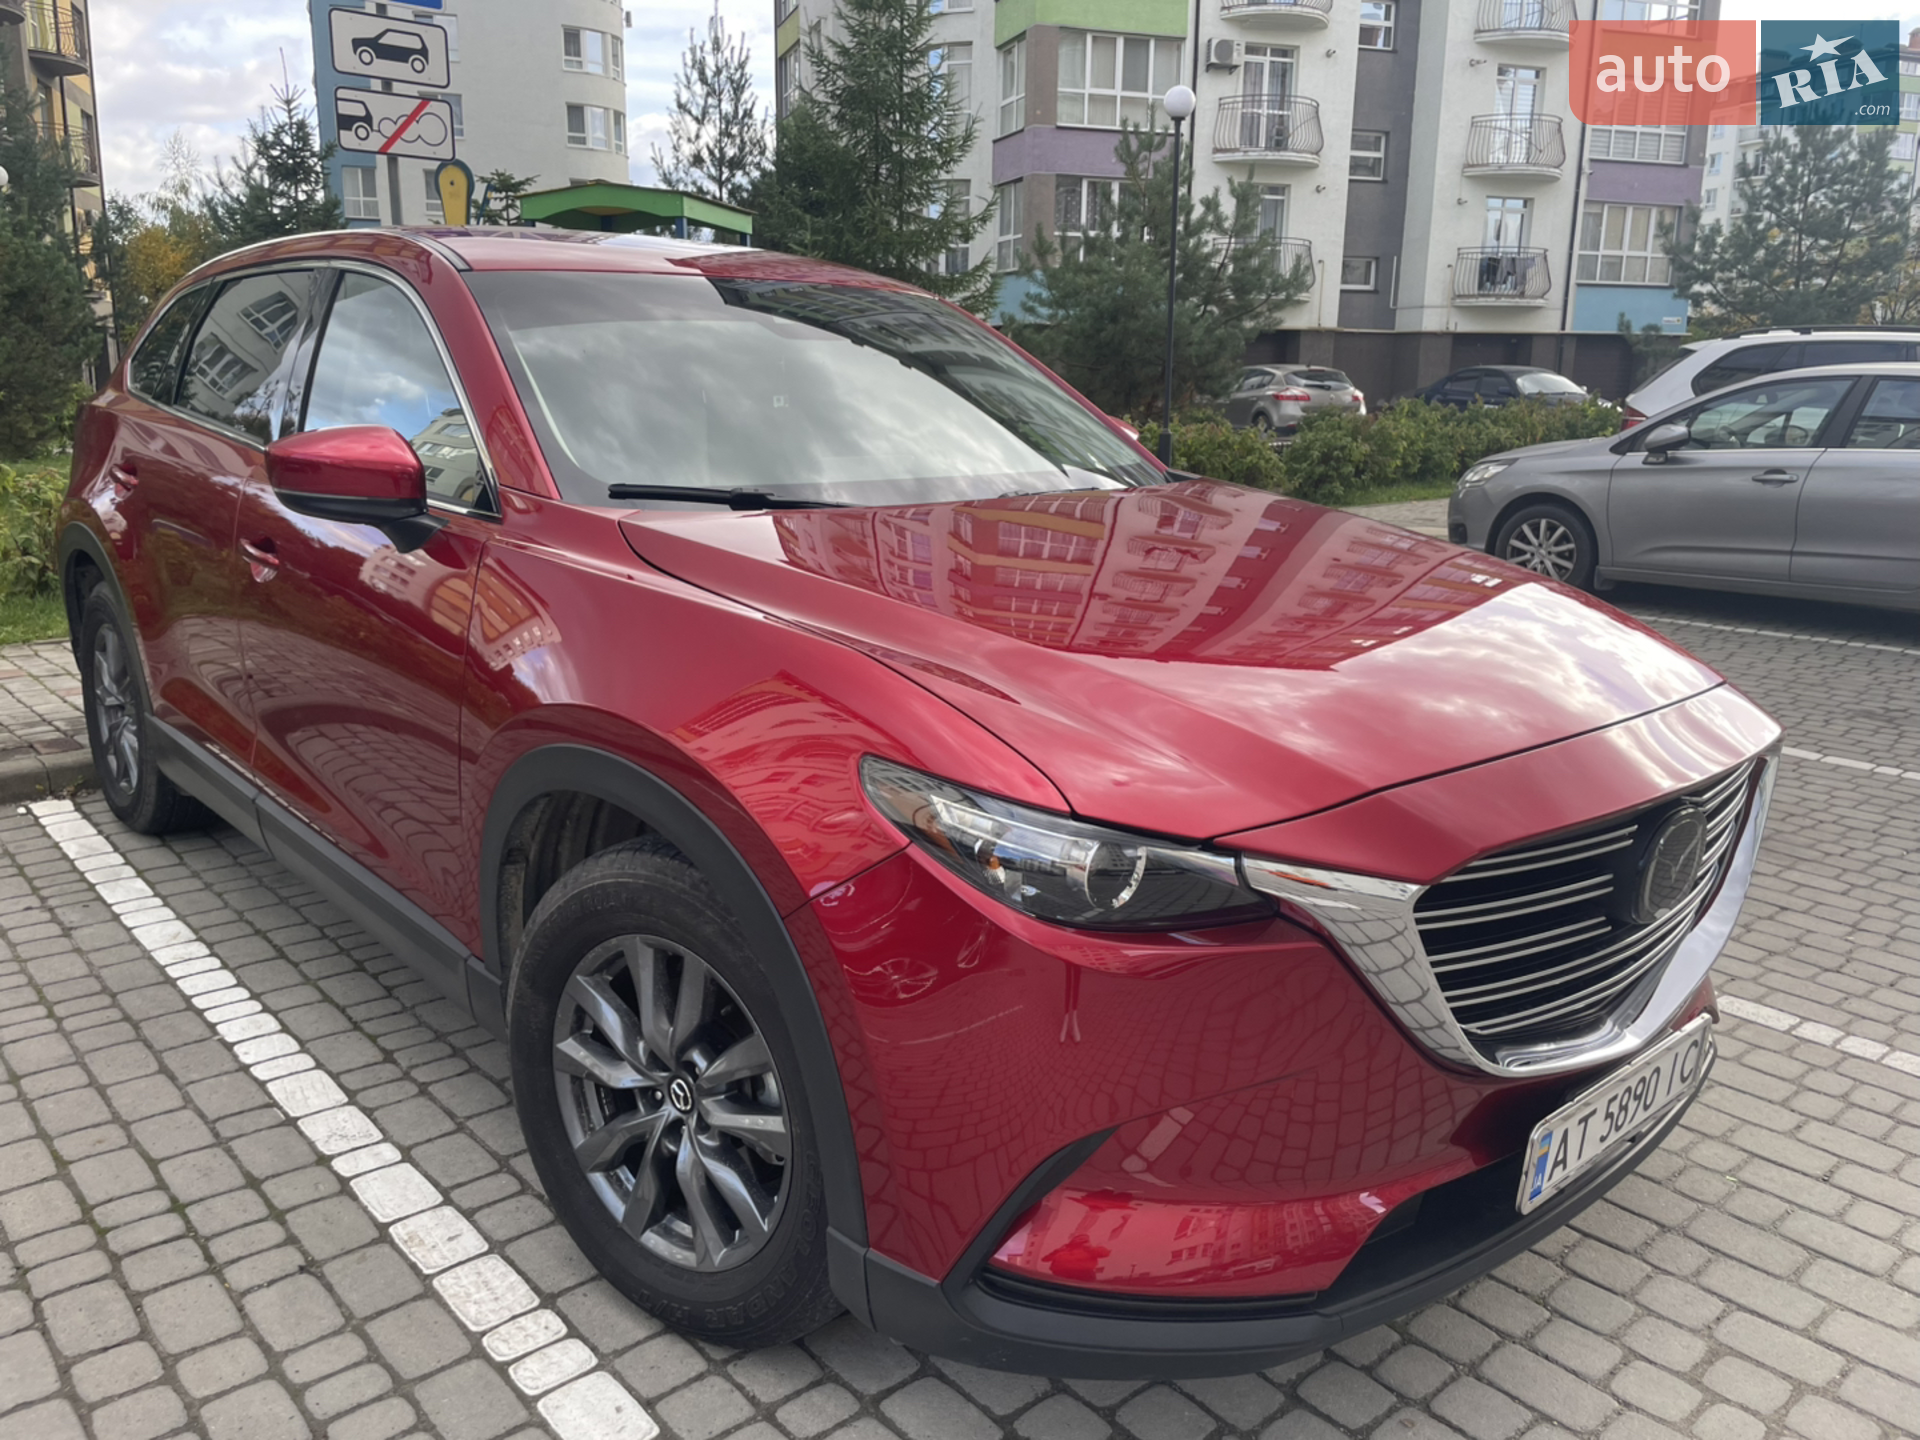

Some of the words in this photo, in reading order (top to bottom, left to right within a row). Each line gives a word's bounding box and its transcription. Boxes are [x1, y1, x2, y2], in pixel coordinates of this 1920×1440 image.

[1548, 1108, 1597, 1182] AT
[1600, 1066, 1661, 1143] 5890
[1666, 1039, 1699, 1096] IC
